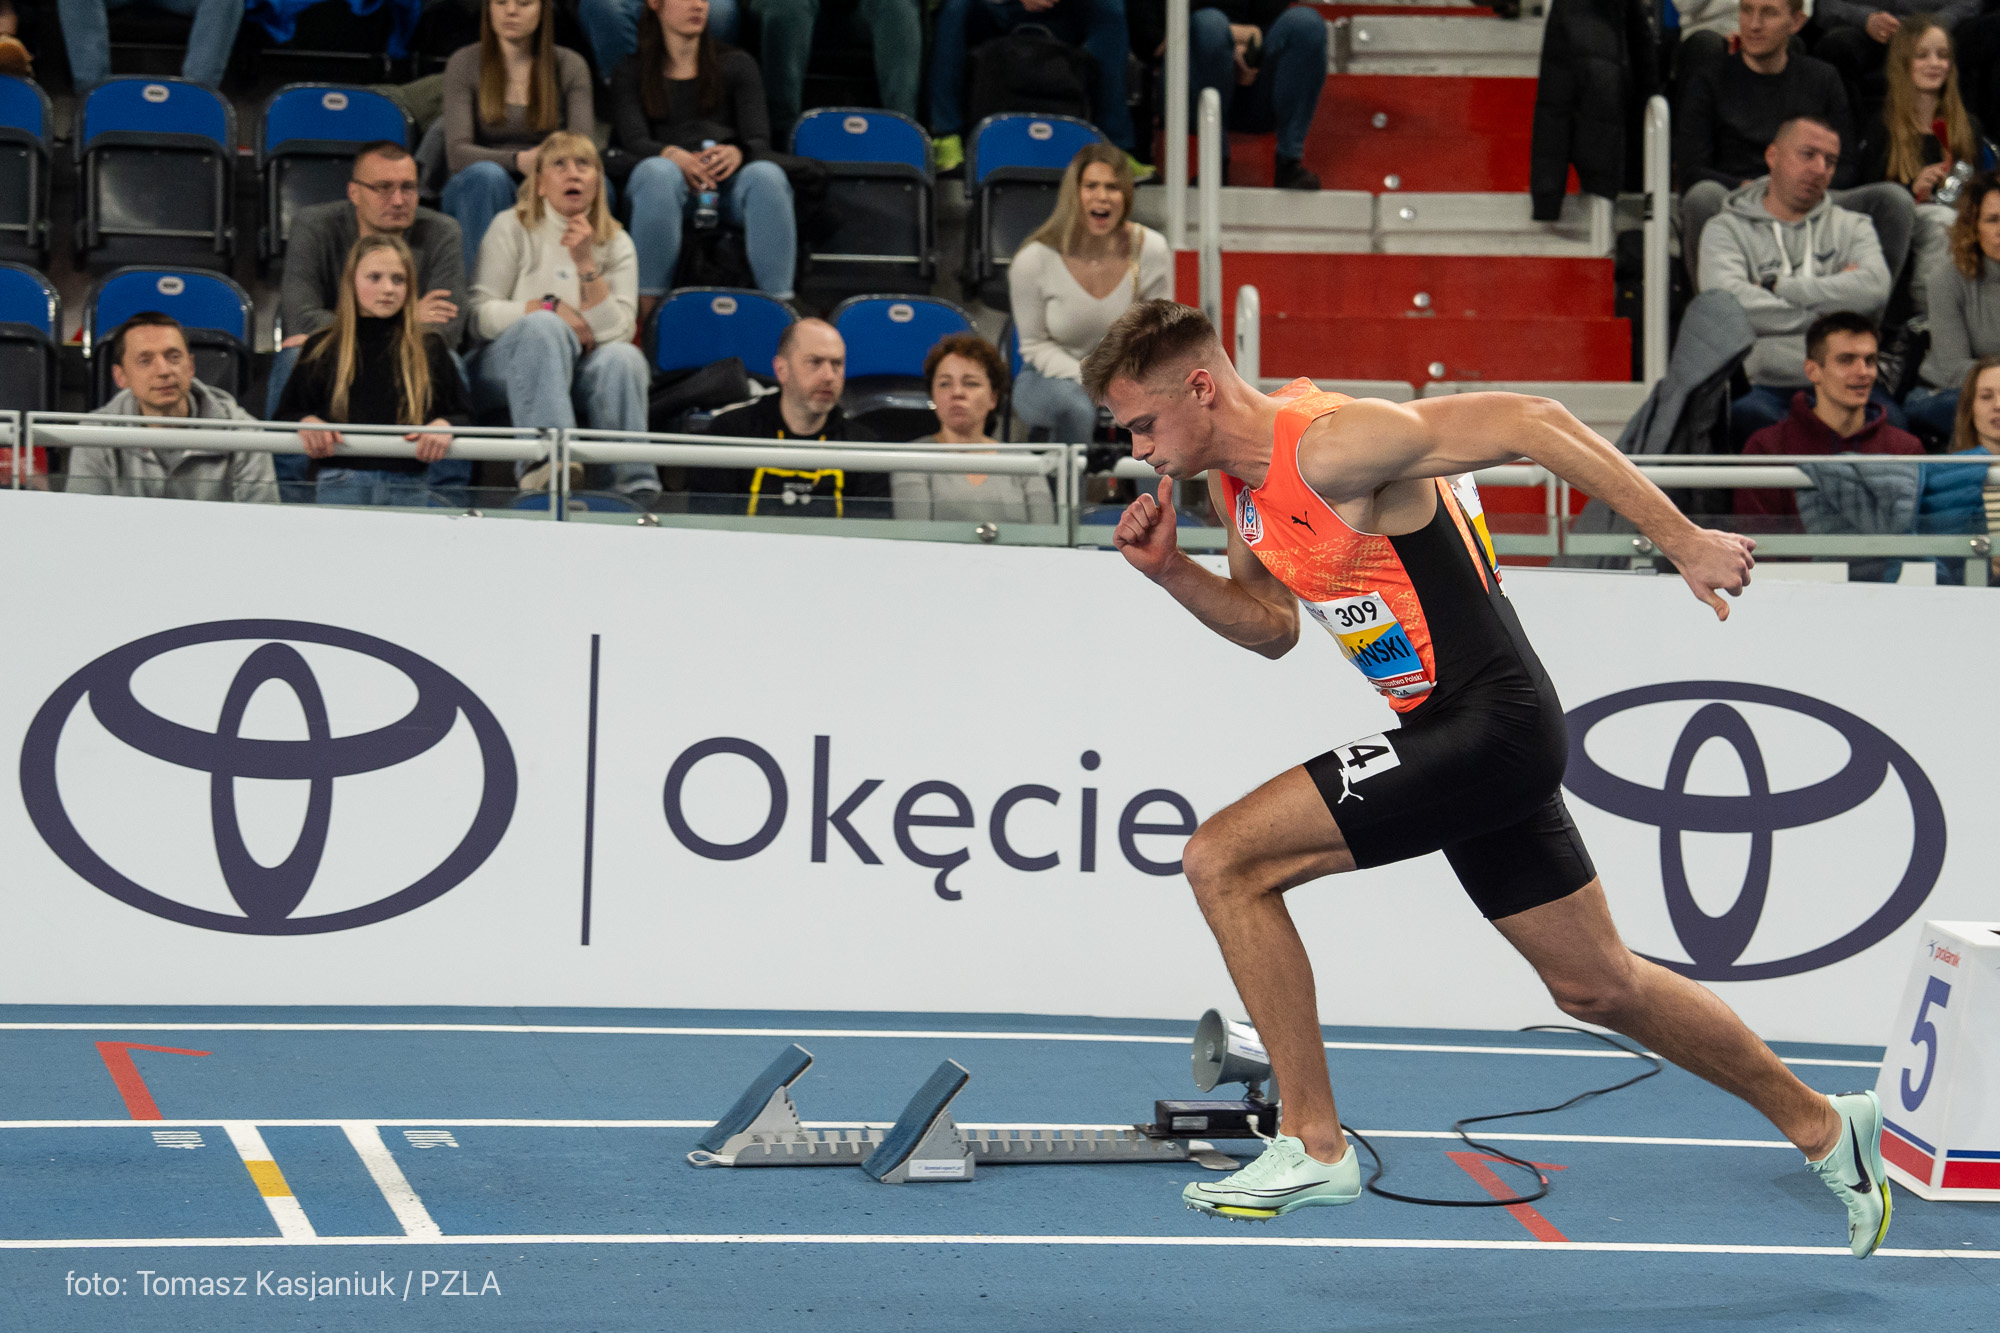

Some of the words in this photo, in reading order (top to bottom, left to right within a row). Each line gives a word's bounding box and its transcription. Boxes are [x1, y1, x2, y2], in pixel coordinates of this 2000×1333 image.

[1335, 601, 1377, 627] 309
[1348, 635, 1411, 667] AŃSKI
[1404, 673, 1423, 683] Polski
[1347, 745, 1391, 769] 4
[663, 735, 1198, 901] Okęcie
[1900, 975, 1951, 1112] 5
